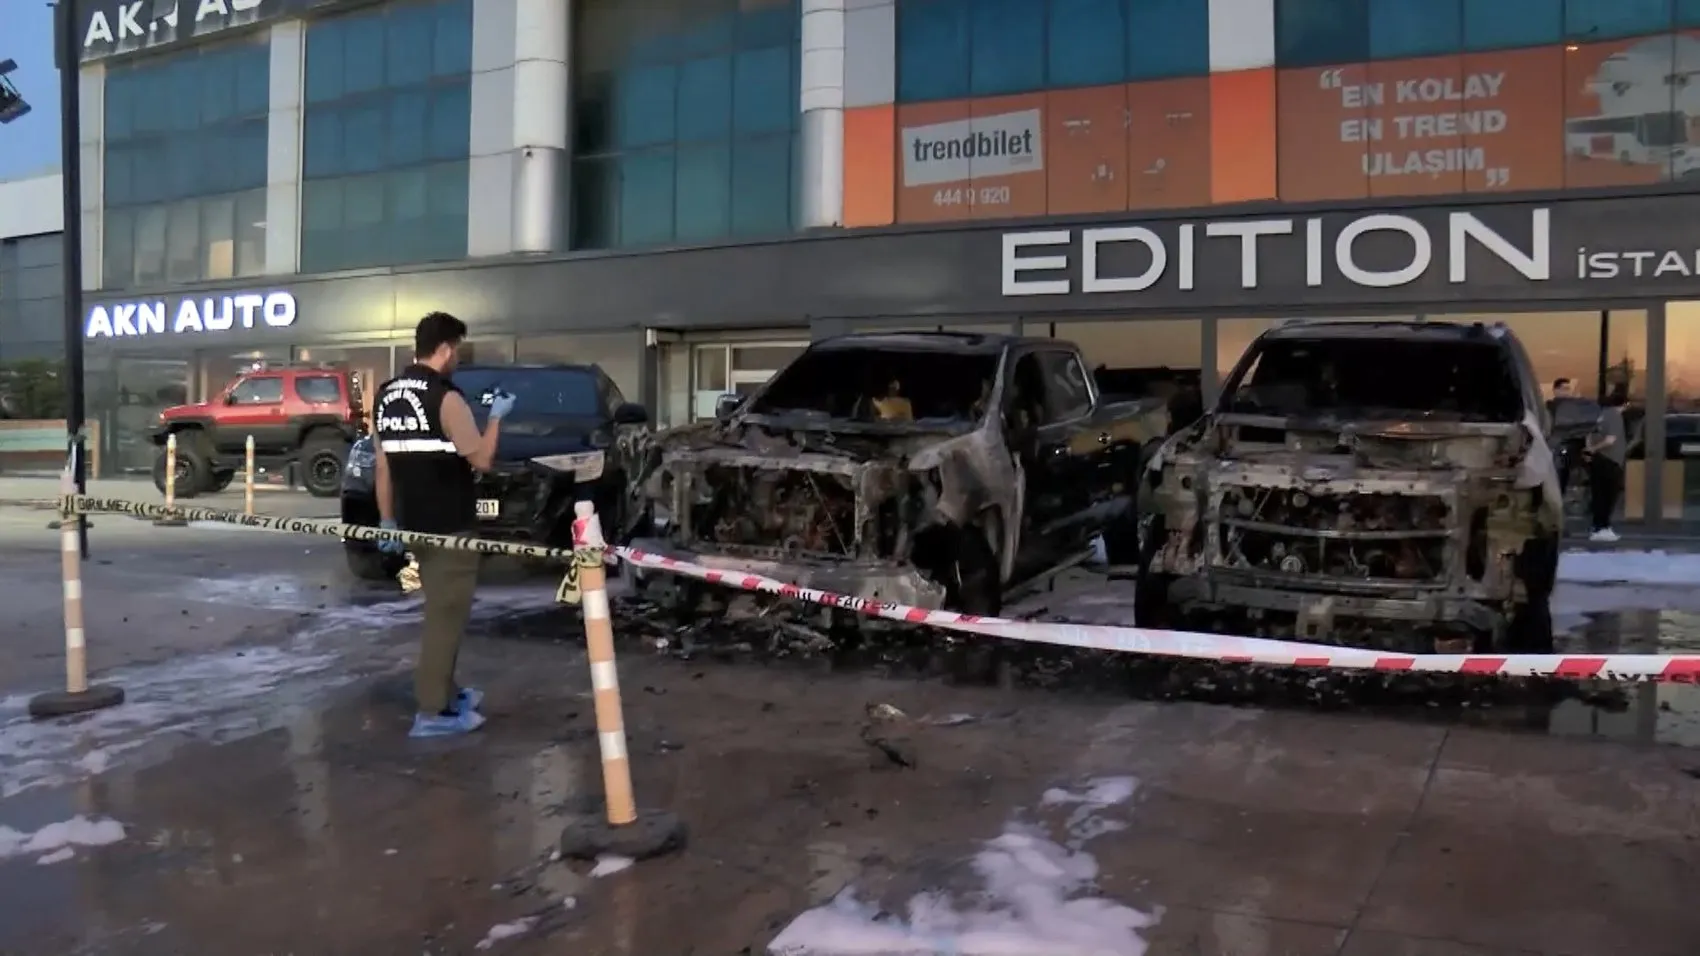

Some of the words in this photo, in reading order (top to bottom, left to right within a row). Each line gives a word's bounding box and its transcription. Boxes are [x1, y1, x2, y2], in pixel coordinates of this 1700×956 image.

[1396, 72, 1506, 104] KOLAY
[1340, 119, 1383, 142] EN
[1393, 109, 1507, 138] TREND
[913, 129, 1032, 162] trendbilet
[932, 188, 961, 206] 444
[980, 186, 1010, 205] 920
[1002, 208, 1550, 296] EDITION
[1577, 247, 1700, 279] İSTA
[86, 301, 165, 338] AKN
[174, 291, 296, 333] AUTO
